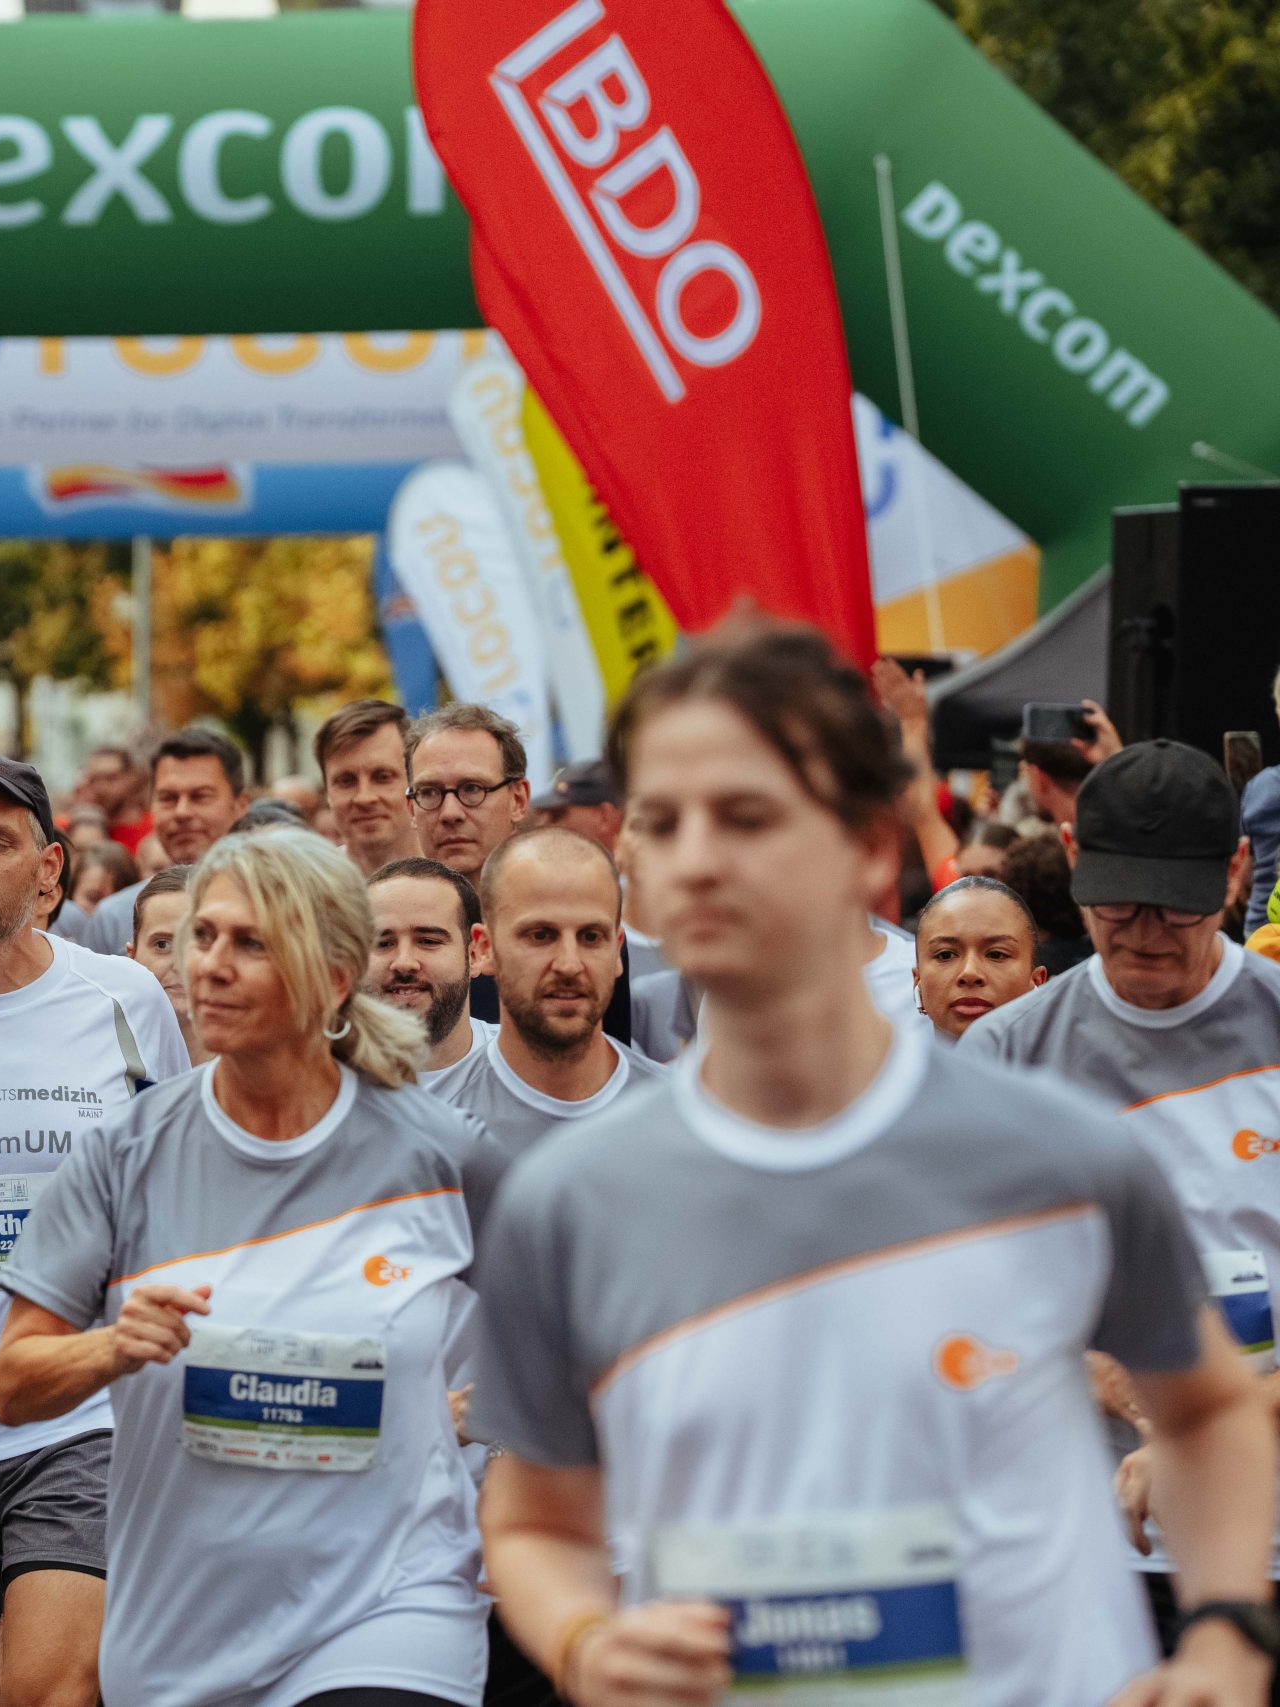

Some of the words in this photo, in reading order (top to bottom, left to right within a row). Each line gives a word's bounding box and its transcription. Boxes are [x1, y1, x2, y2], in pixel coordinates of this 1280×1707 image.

[539, 33, 762, 368] BDO
[902, 180, 1171, 430] Dexcom
[228, 1373, 338, 1408] Claudia
